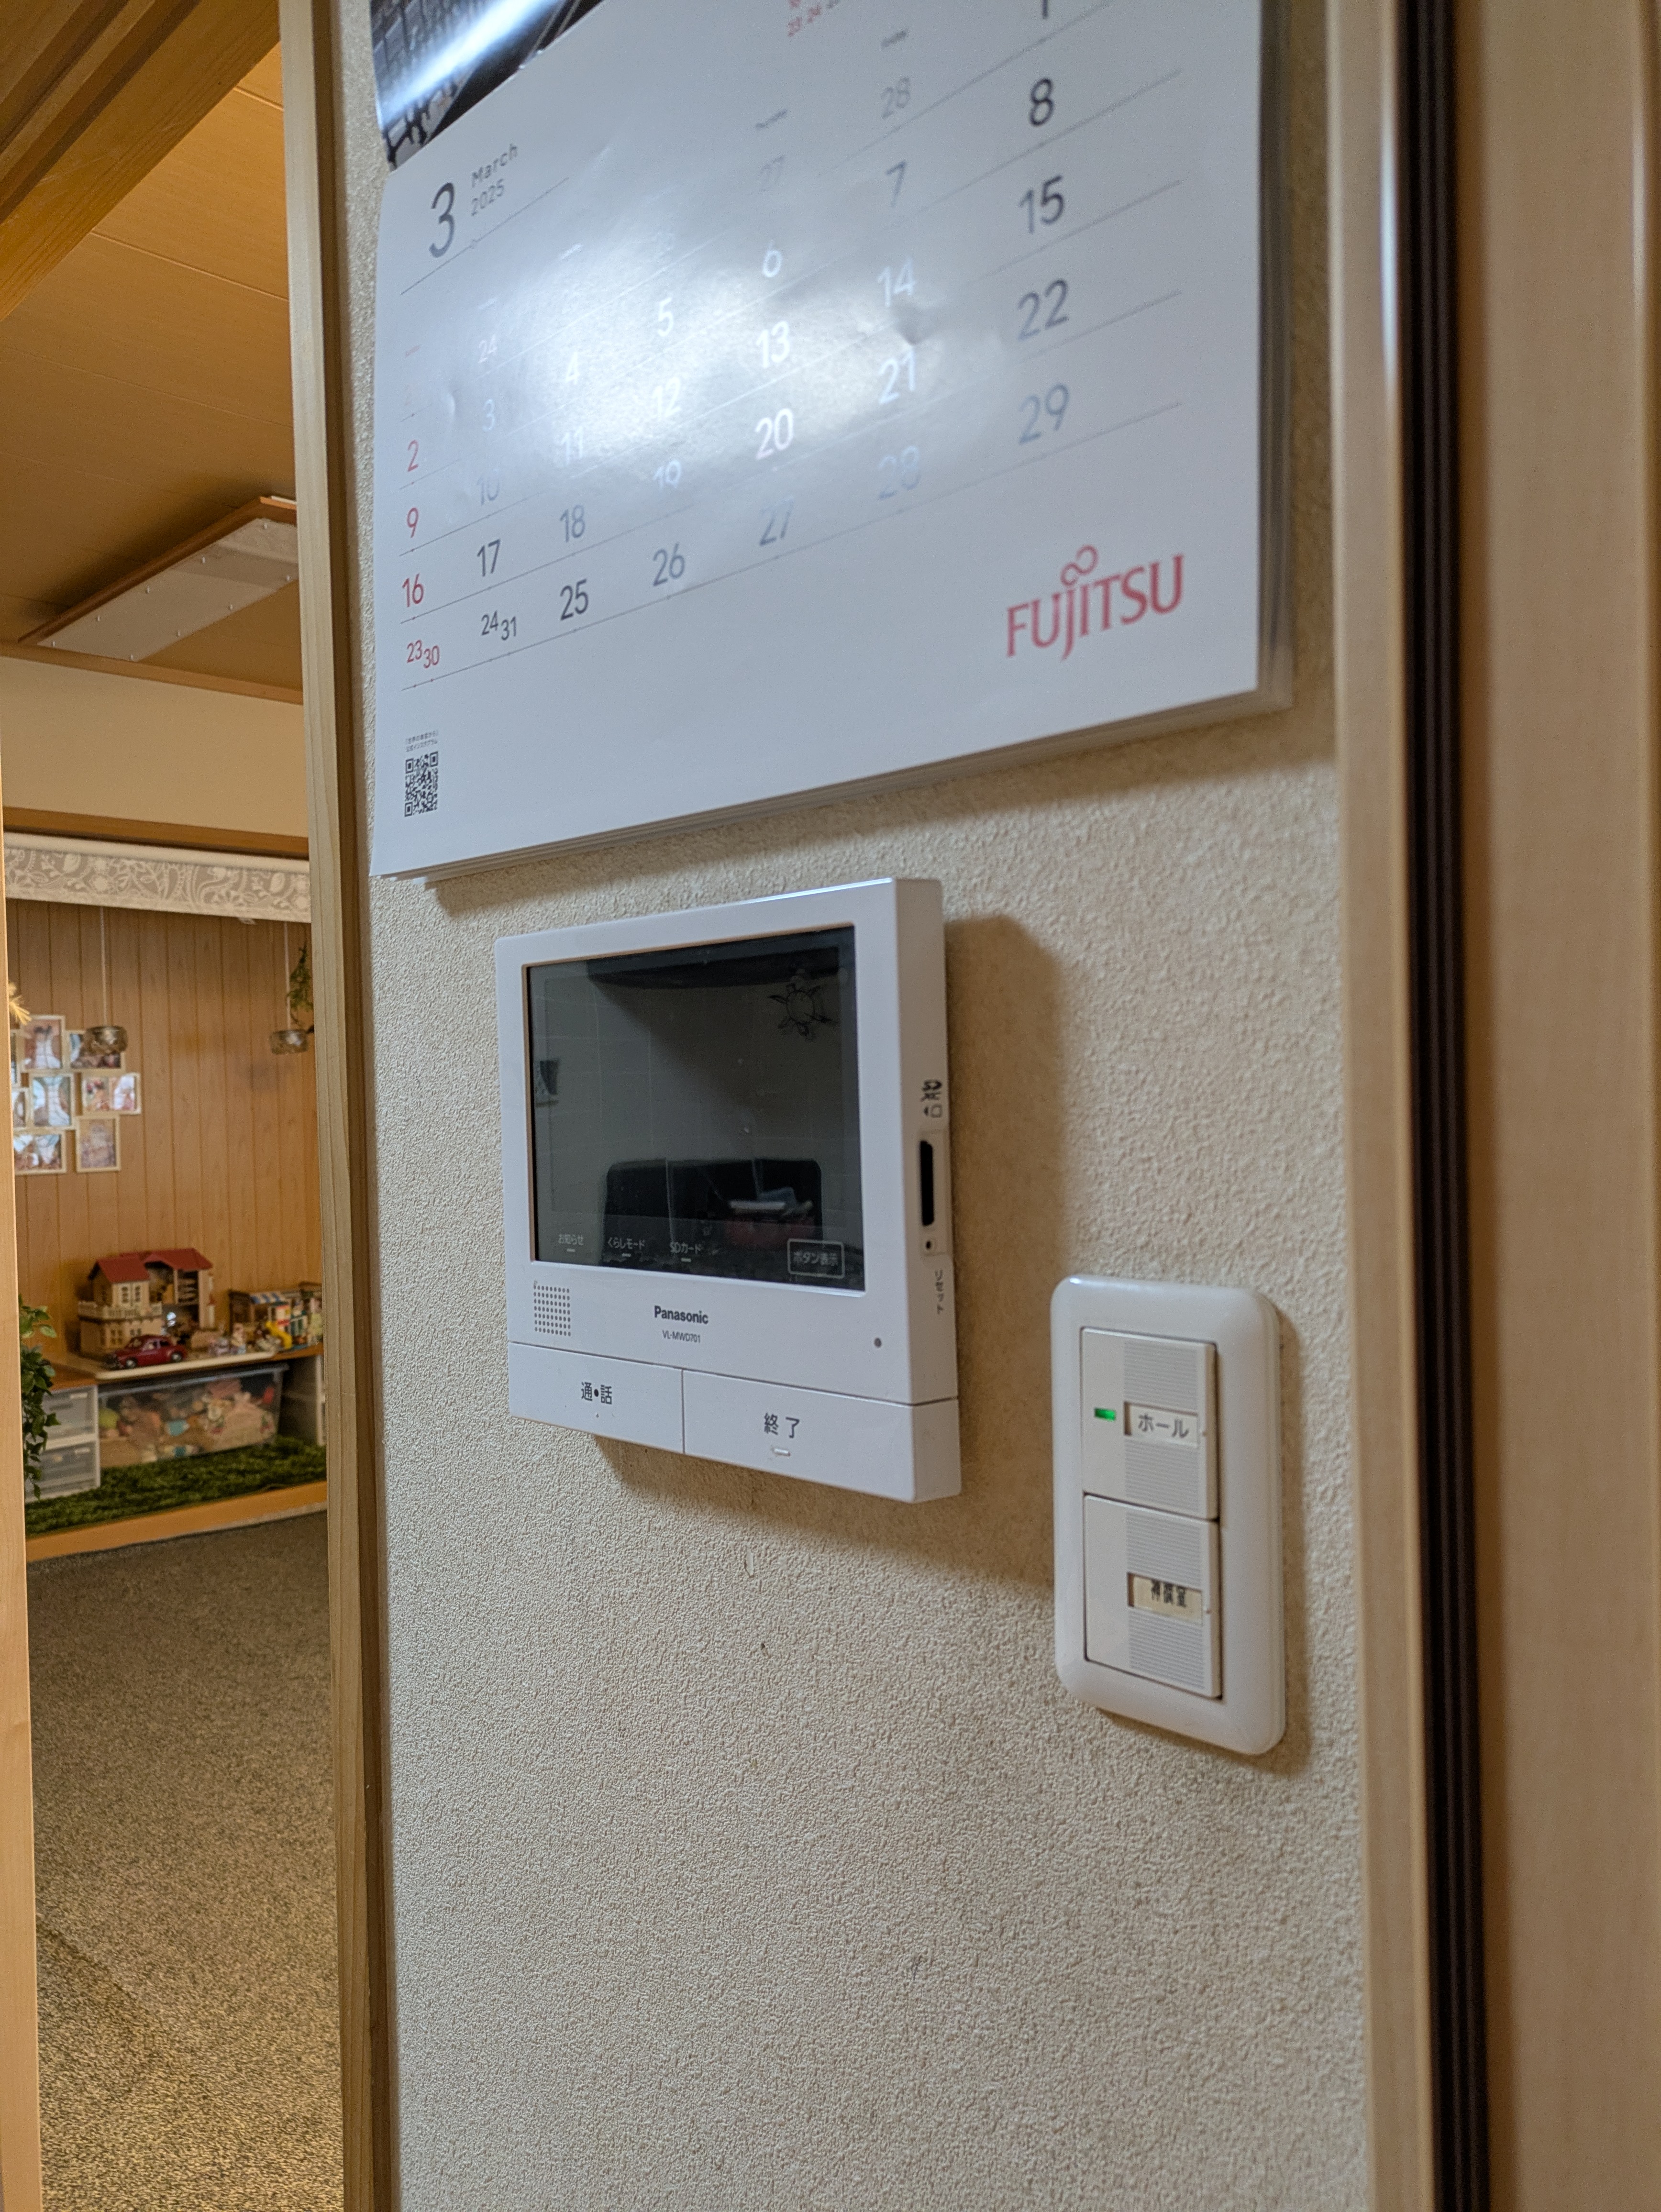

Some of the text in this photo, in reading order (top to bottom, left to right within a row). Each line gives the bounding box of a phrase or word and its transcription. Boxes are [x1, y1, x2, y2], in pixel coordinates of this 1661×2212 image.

[881, 77, 910, 119] 28
[471, 144, 518, 188] March
[471, 178, 505, 216] 2025
[429, 182, 455, 258] 3
[407, 77, 1055, 472] 2 3 4 5 6 7 8
[407, 175, 1065, 538] 9 10 11 12 13 14 15
[402, 573, 424, 607] 16
[477, 539, 501, 577] 17
[559, 504, 586, 543] 18
[755, 408, 794, 460] 20
[877, 346, 917, 404] 21
[1017, 277, 1069, 342] 22
[407, 383, 1070, 669] 23 30 24 31 25 26 27 28 29
[1007, 544, 1184, 662] FUJITSU
[558, 1234, 584, 1246] お知らせ
[608, 1236, 646, 1250] くらしモード
[669, 1241, 703, 1255] SDカード
[794, 1250, 838, 1266] ボタン表示
[654, 1305, 709, 1325] Panasonic
[662, 1329, 700, 1343] VL-MWD701
[764, 1413, 800, 1438] 終了
[1138, 1413, 1190, 1438] ホール
